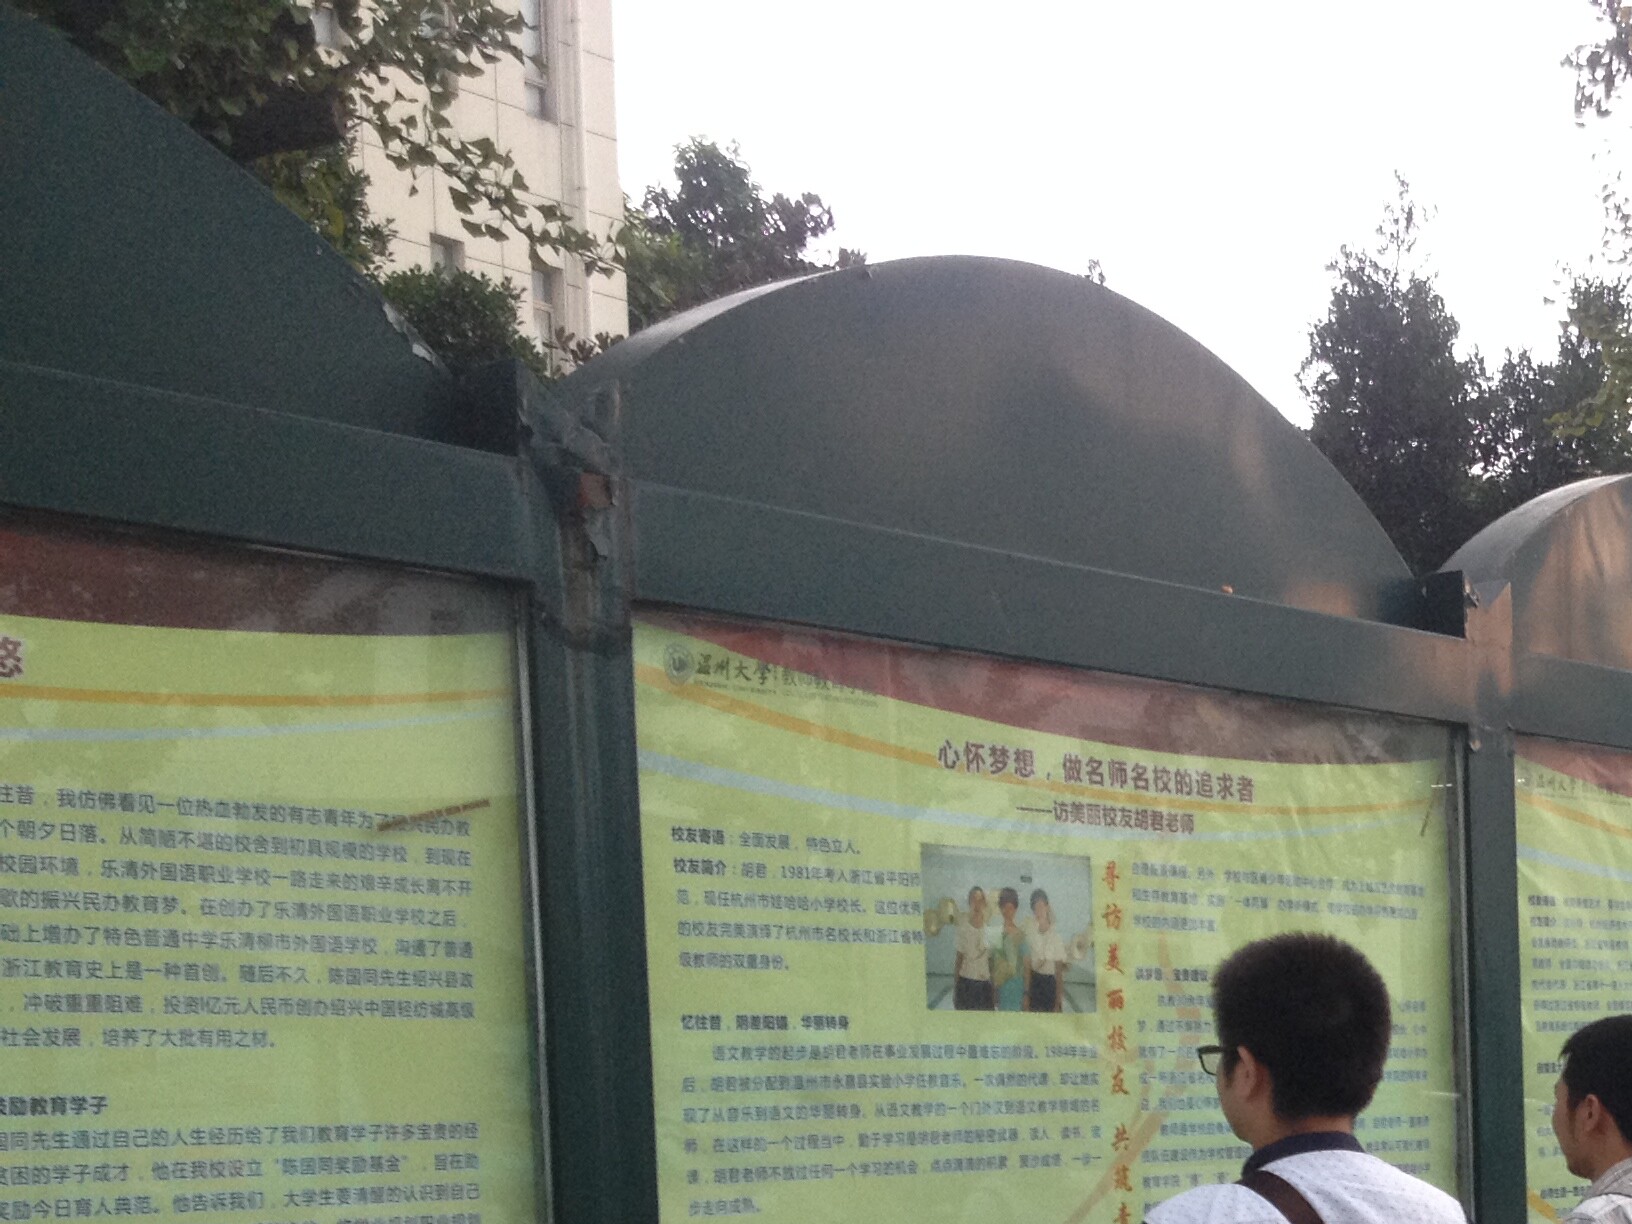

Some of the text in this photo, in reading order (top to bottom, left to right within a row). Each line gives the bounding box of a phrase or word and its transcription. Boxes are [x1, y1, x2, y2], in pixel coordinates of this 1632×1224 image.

[937, 739, 1255, 803] 心怀梦想，做名师名校的追求者
